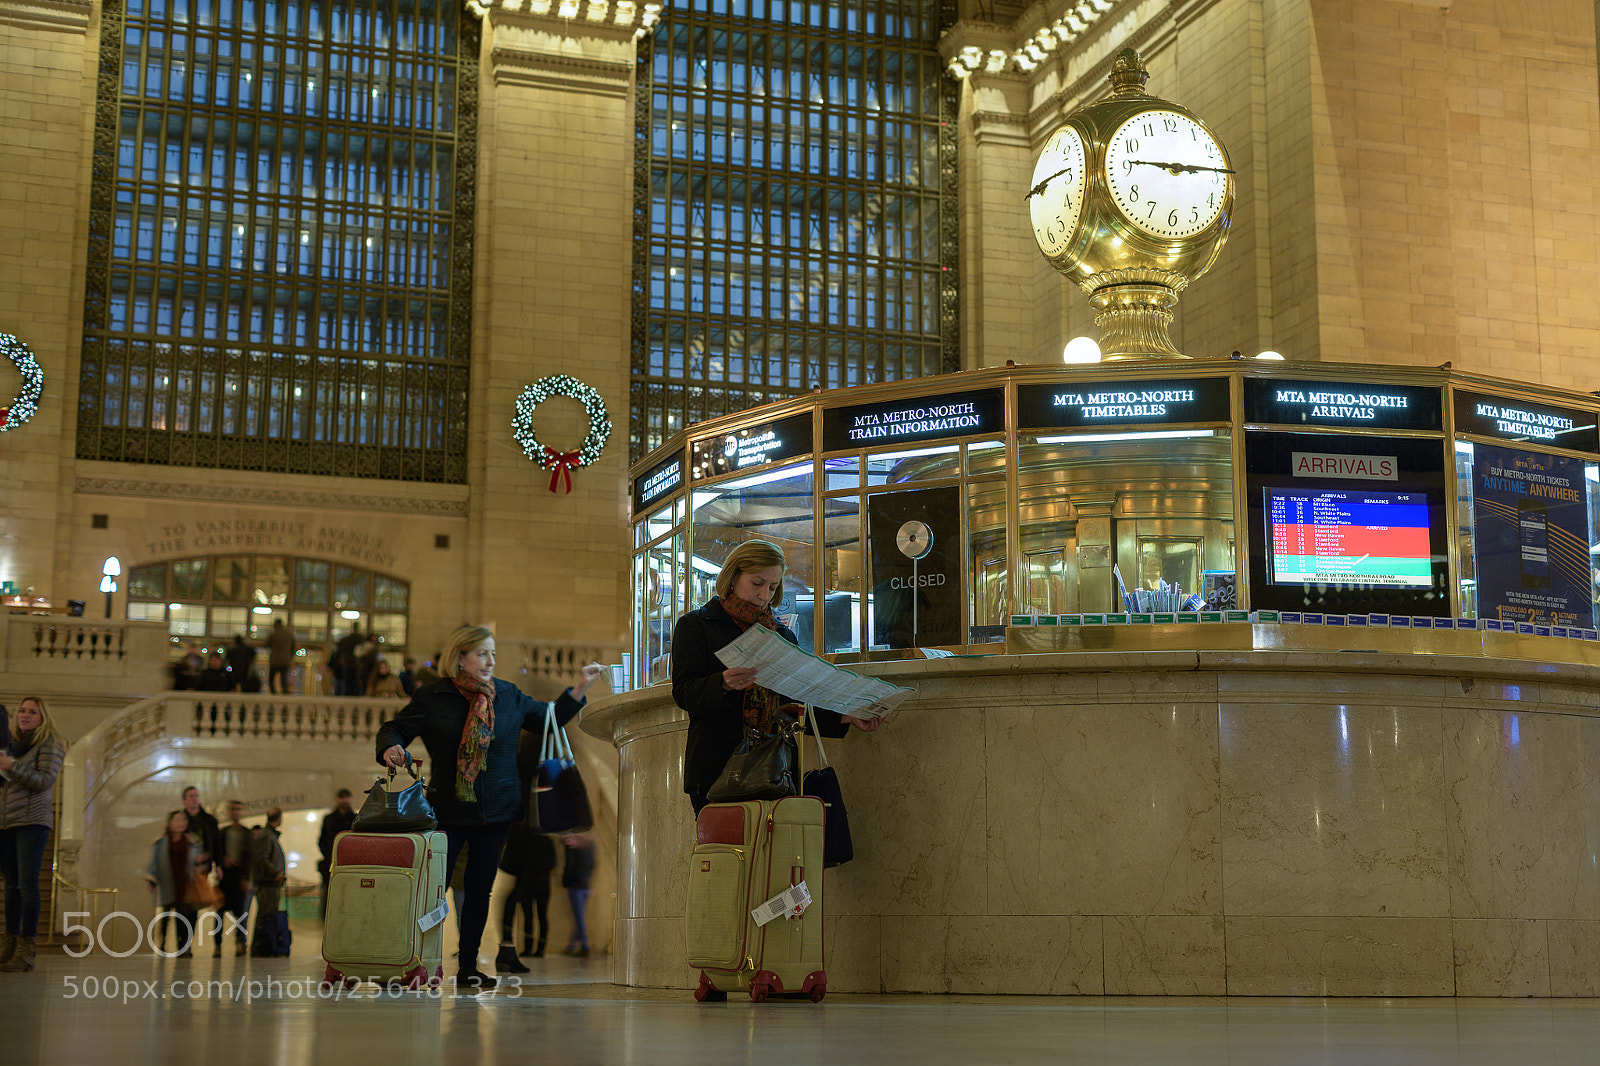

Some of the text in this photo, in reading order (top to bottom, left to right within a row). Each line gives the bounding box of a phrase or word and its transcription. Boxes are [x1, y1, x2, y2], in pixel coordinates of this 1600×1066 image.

[1143, 124, 1154, 136] 11
[1164, 119, 1178, 132] 12
[1191, 128, 1197, 141] 1
[1126, 138, 1139, 154] 10
[1204, 143, 1214, 158] 2
[1123, 160, 1132, 177] 9
[1063, 194, 1072, 209] 4
[1129, 185, 1139, 202] 8
[1206, 193, 1214, 208] 4
[1147, 201, 1157, 218] 7
[1189, 206, 1198, 223] 5
[1056, 216, 1065, 233] 5
[1168, 209, 1178, 227] 6
[1046, 226, 1056, 244] 6
[1054, 390, 1194, 405] MTA METRO-NORTH
[1276, 391, 1407, 407] MTA METRO-NORTH
[854, 403, 974, 427] MTA METRO-NORTH
[1082, 404, 1166, 417] TIMETABLES
[1311, 406, 1375, 419] ARRIVALS
[1477, 404, 1574, 429] MTA METRO-NORTH
[849, 415, 980, 440] TRAIN INFORMATION
[1497, 420, 1555, 439] TIMETABLES
[738, 440, 781, 456] Transportation
[1298, 457, 1392, 476] ARRIVALS
[1491, 467, 1570, 486] BUY METRO-NORTH TICKETS
[1484, 476, 1580, 502] ANYTIME, ANYWHERE
[162, 524, 186, 537] TO
[147, 538, 183, 554] THE
[890, 574, 946, 589] CLOSED
[1496, 605, 1502, 620] 1
[1528, 609, 1536, 624] 2
[1550, 612, 1558, 625] 3
